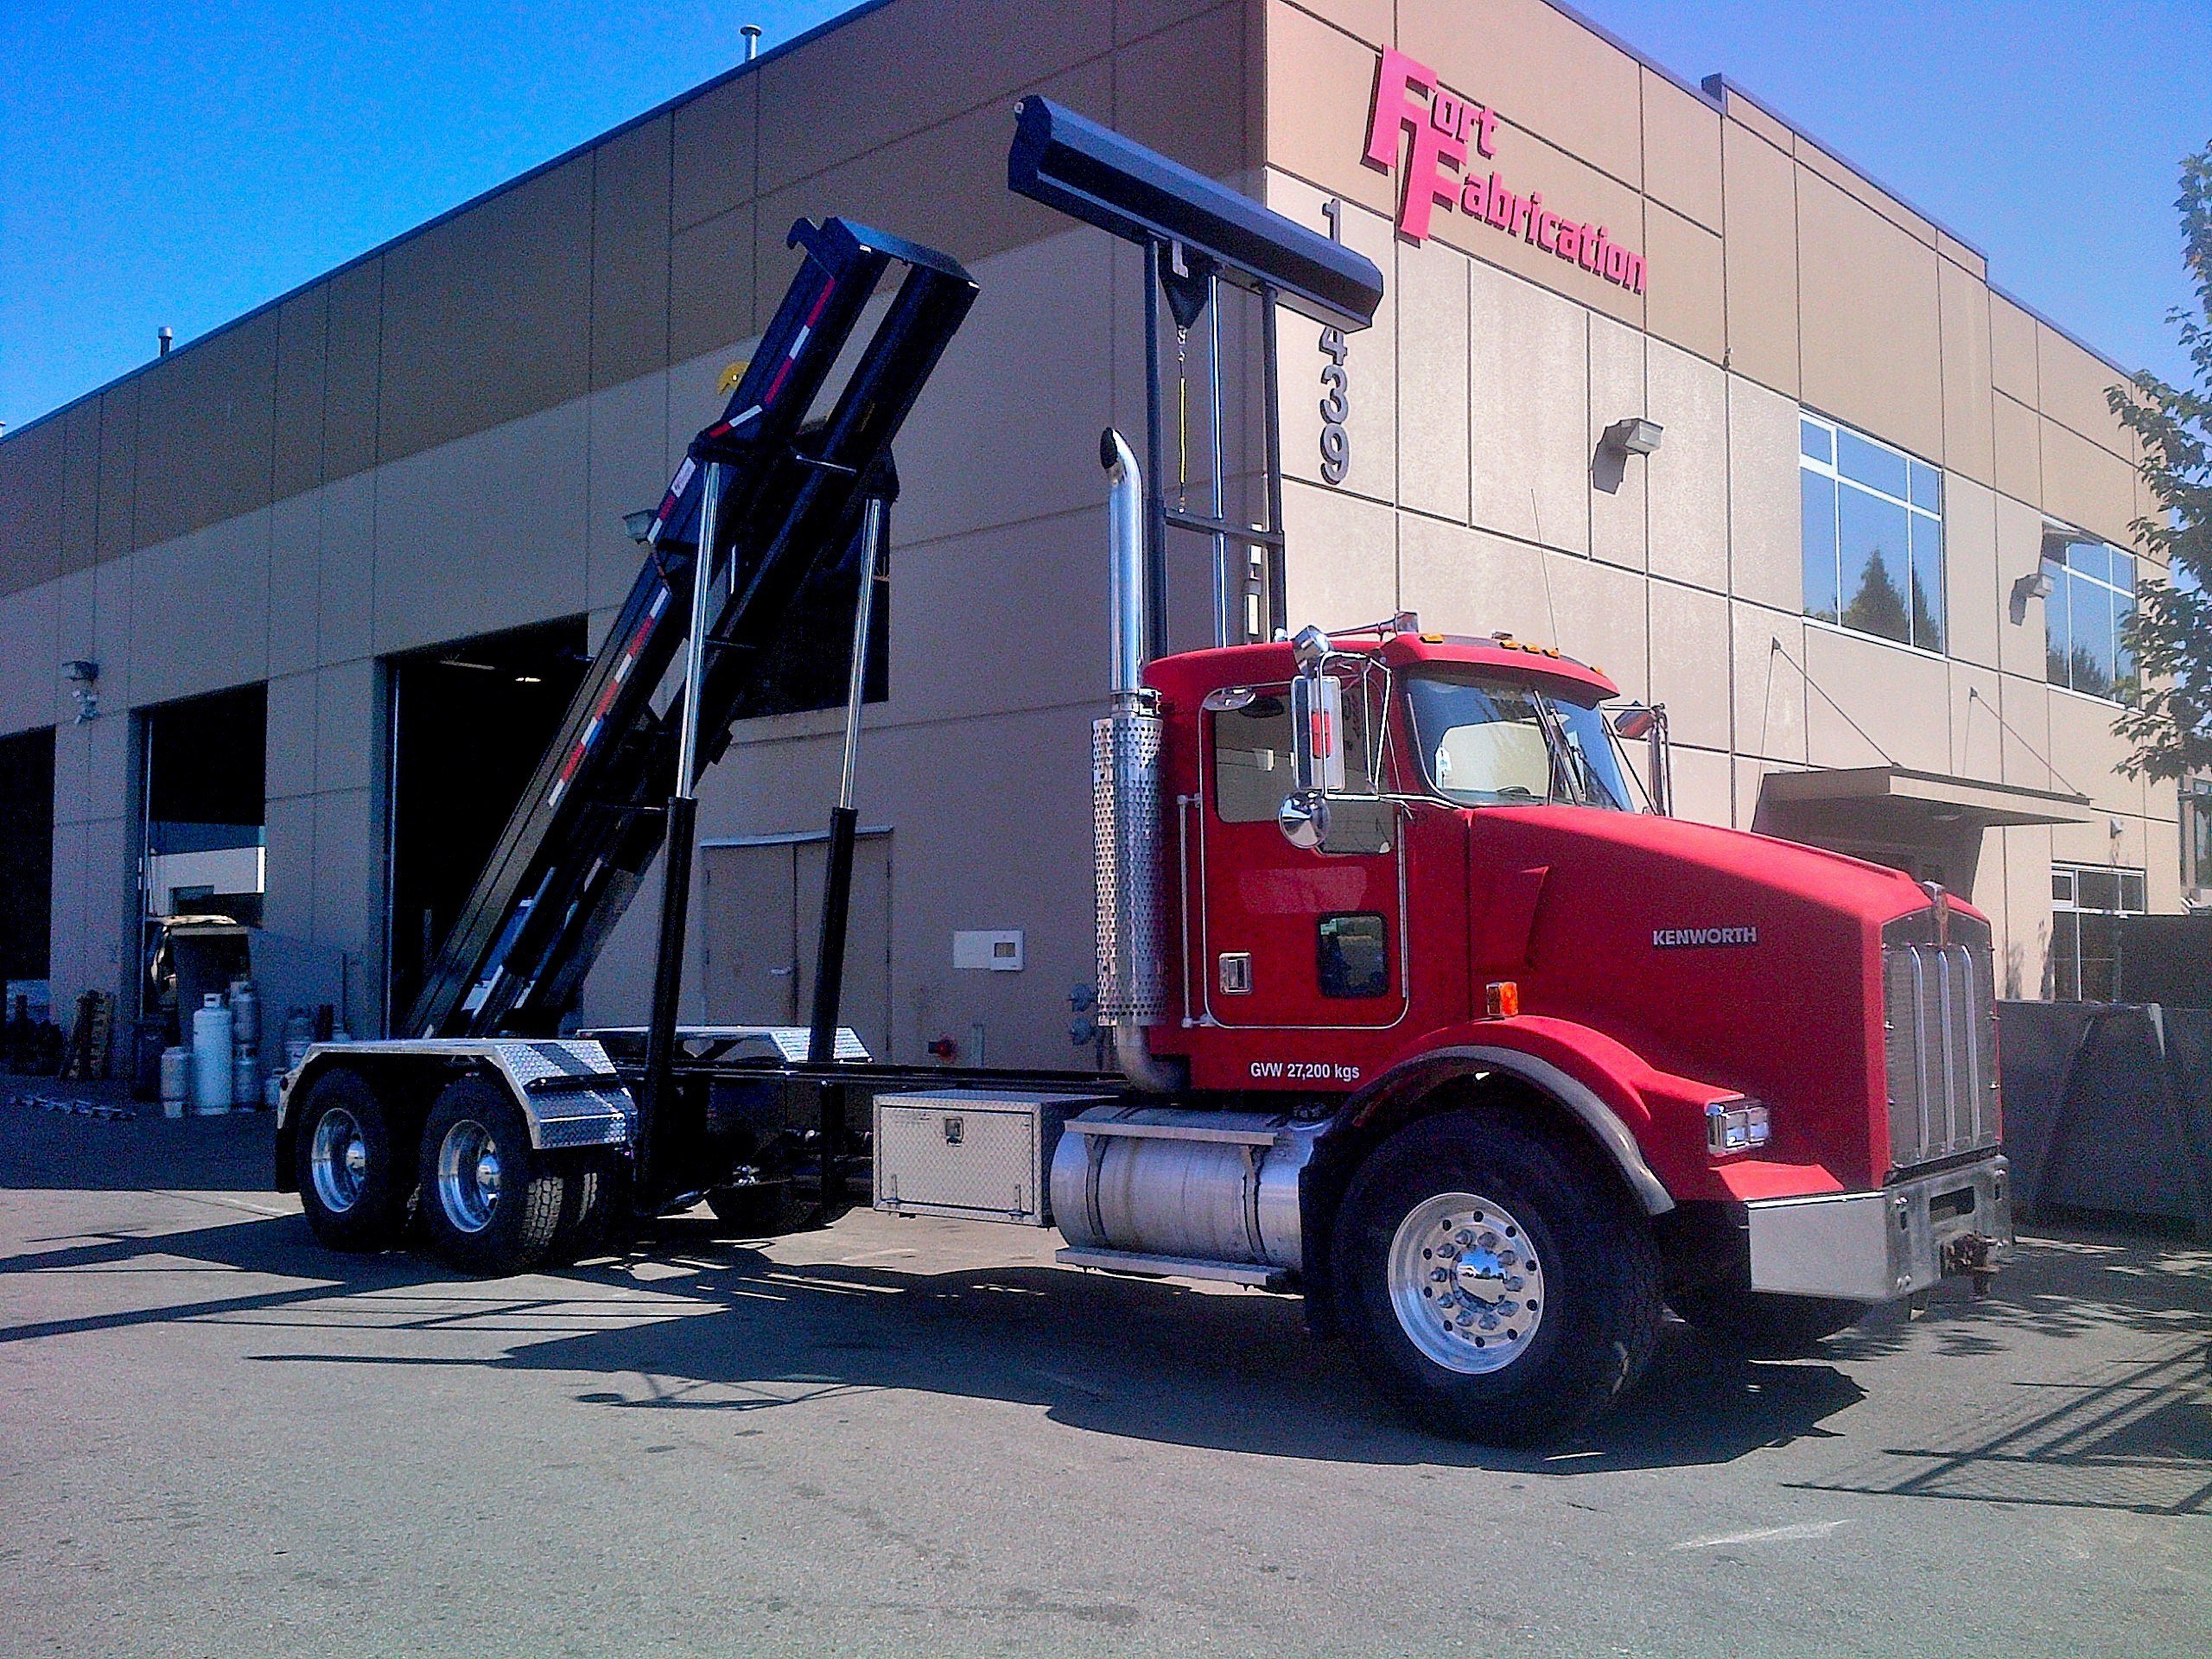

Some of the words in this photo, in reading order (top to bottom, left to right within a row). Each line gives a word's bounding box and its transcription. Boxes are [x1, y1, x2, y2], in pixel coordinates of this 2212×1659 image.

[1365, 44, 1498, 169] Fort
[1400, 126, 1647, 292] Fabrication
[1653, 926, 1757, 945] KENWORTH
[1250, 1062, 1283, 1077] GVW
[1287, 1064, 1330, 1080] 27,200
[1334, 1064, 1360, 1082] kgs
